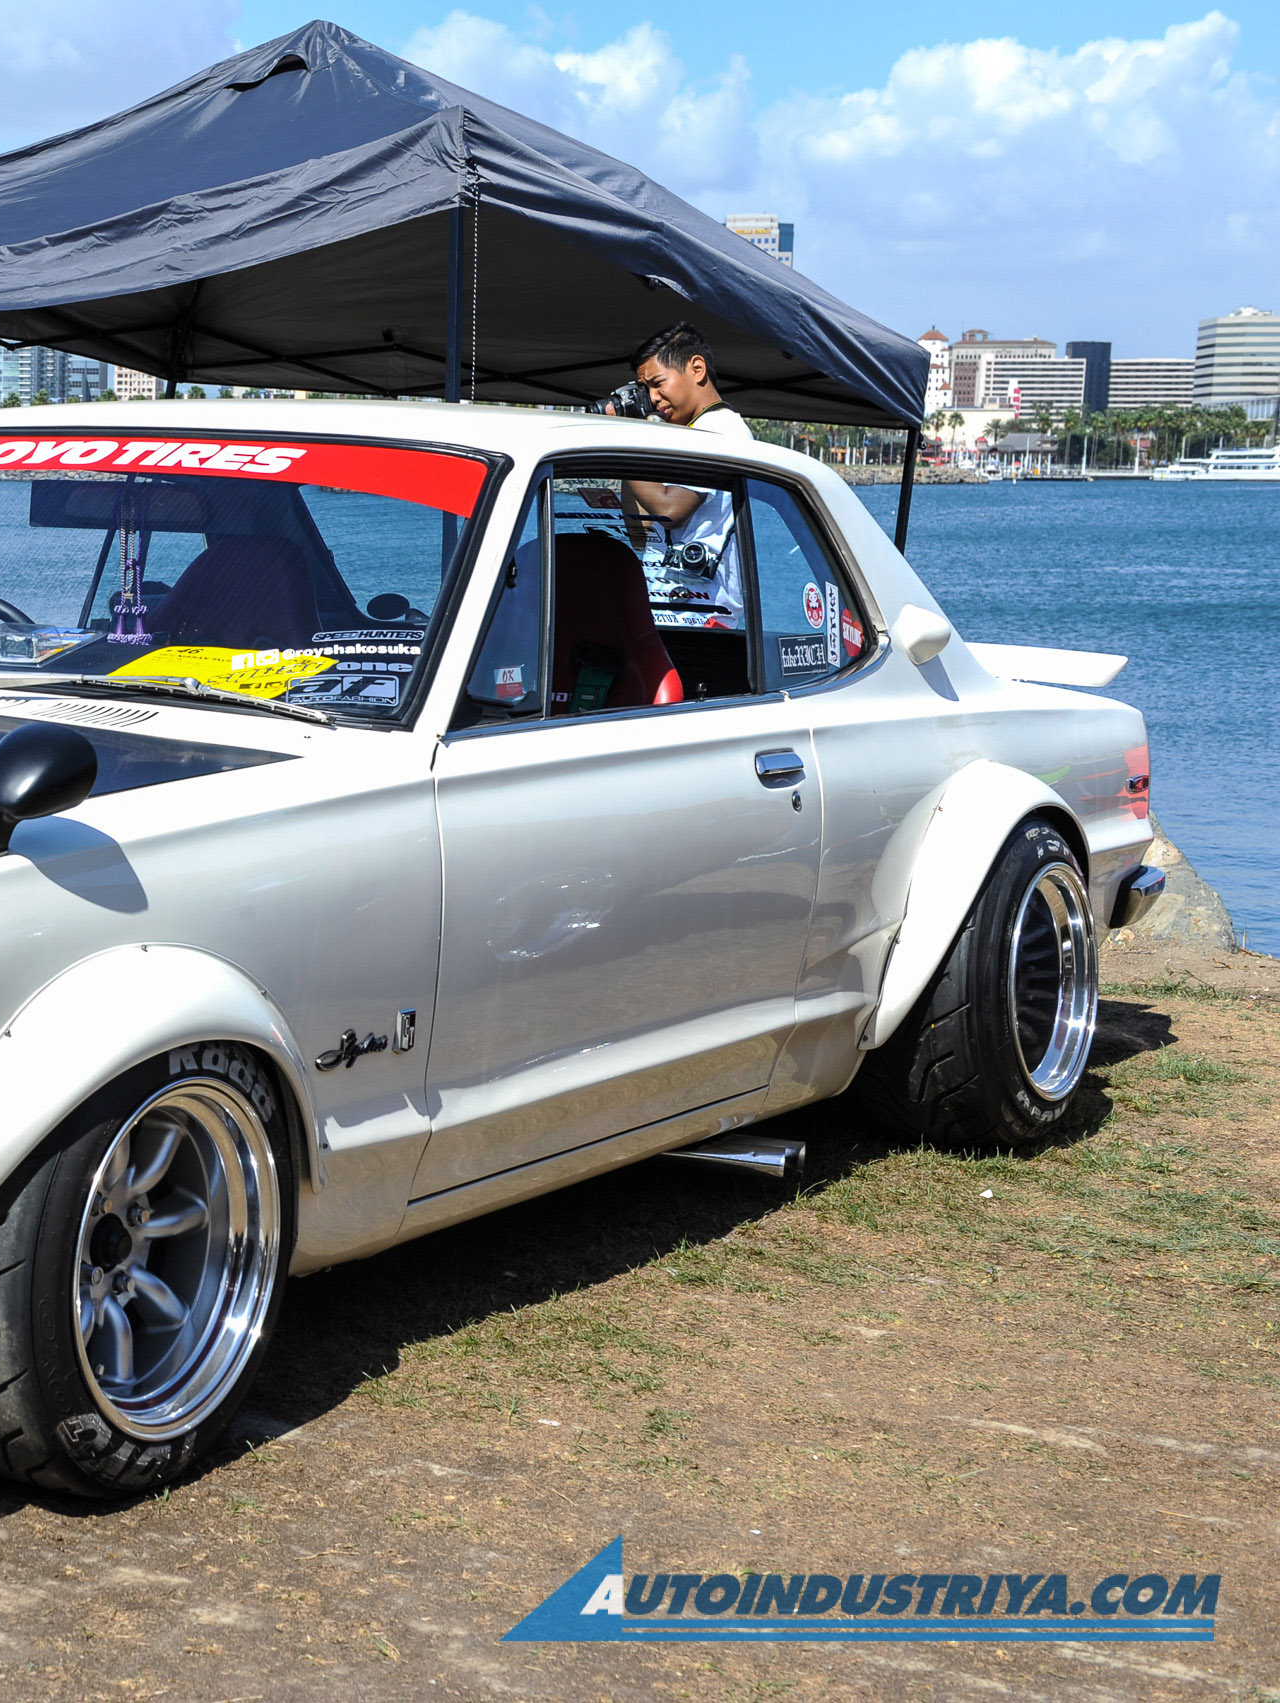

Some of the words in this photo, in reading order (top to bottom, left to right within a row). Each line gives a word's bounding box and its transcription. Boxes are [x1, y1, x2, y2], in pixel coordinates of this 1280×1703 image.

[112, 442, 308, 474] TIRES
[314, 630, 424, 641] SPEEDHUNTERS
[282, 643, 421, 661] @royshakosuka
[336, 661, 413, 673] one
